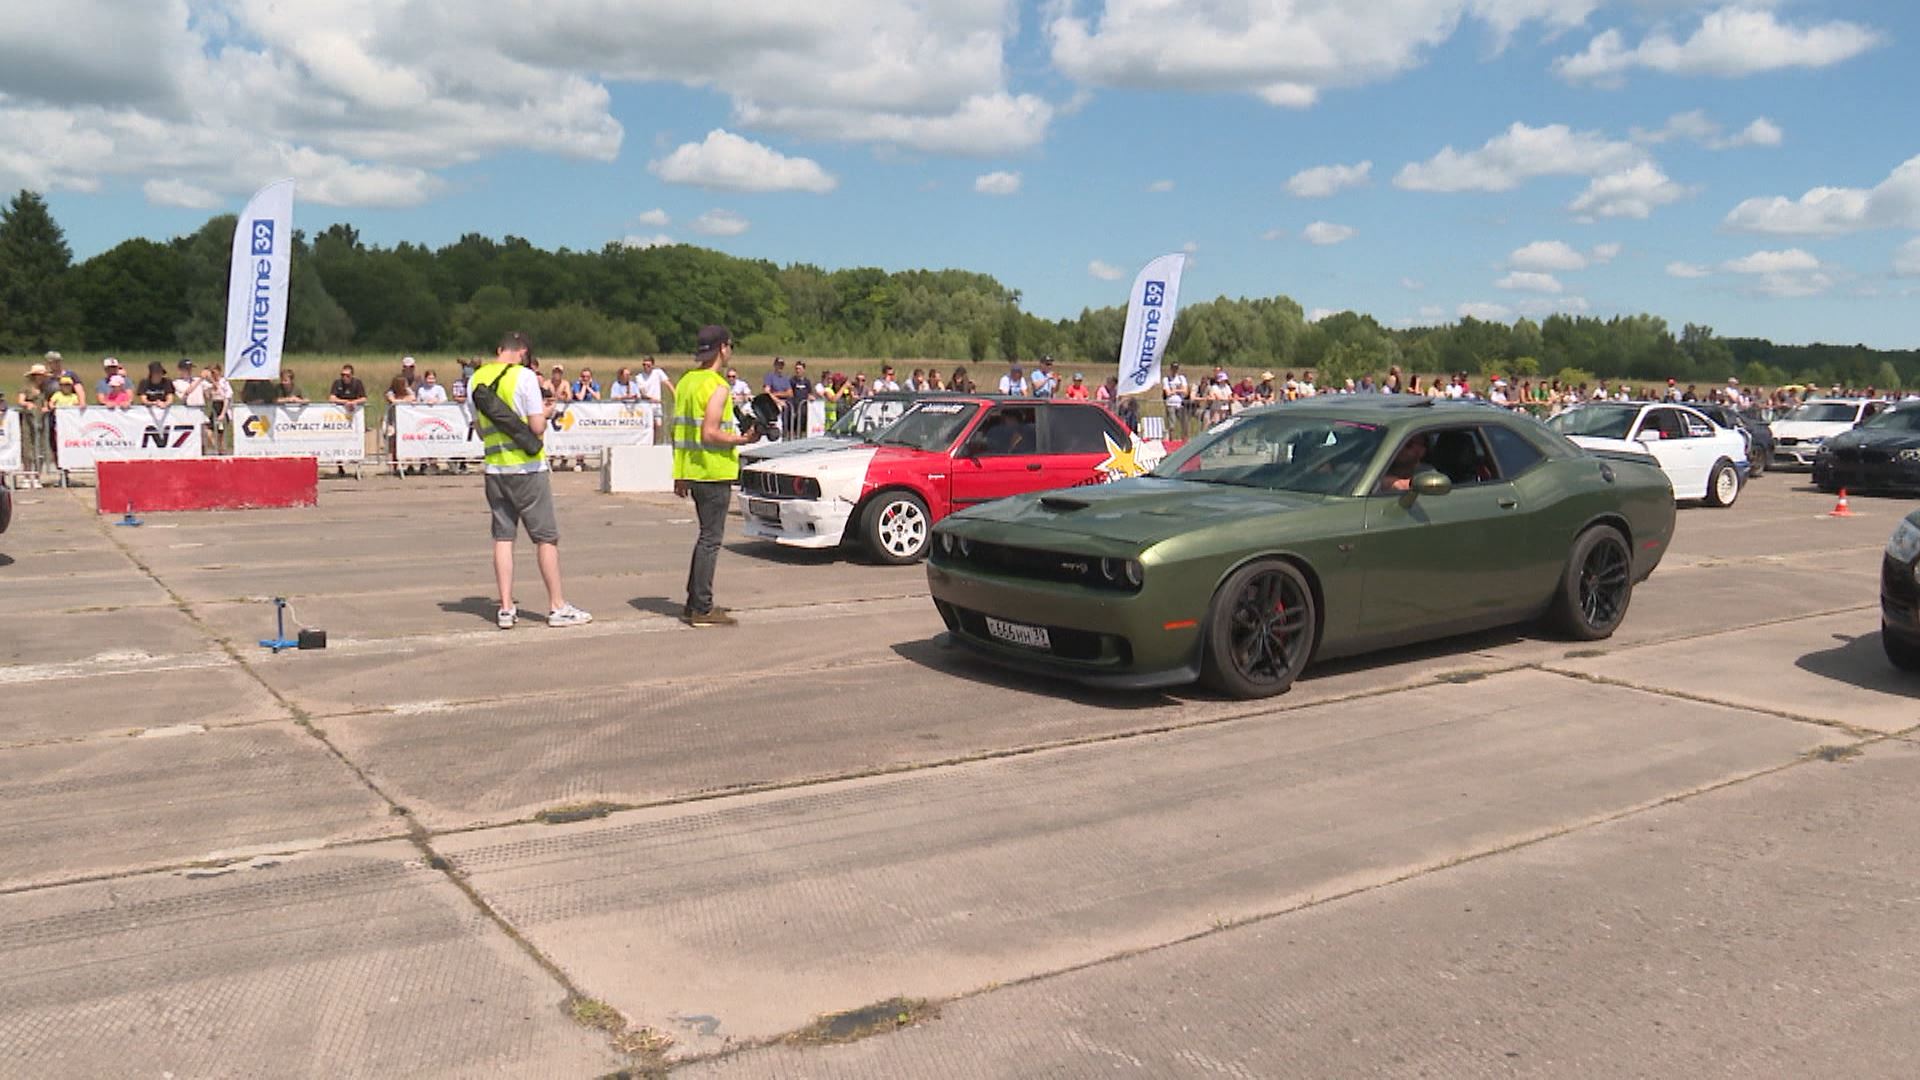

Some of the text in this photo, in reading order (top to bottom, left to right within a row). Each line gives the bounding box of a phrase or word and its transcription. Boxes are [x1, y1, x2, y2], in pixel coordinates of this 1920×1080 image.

[255, 223, 272, 250] 39
[1147, 283, 1163, 303] 39
[275, 422, 353, 431] CONTACT MEDIA
[578, 418, 645, 427] CONTACT MEDIA
[142, 425, 194, 448] N7
